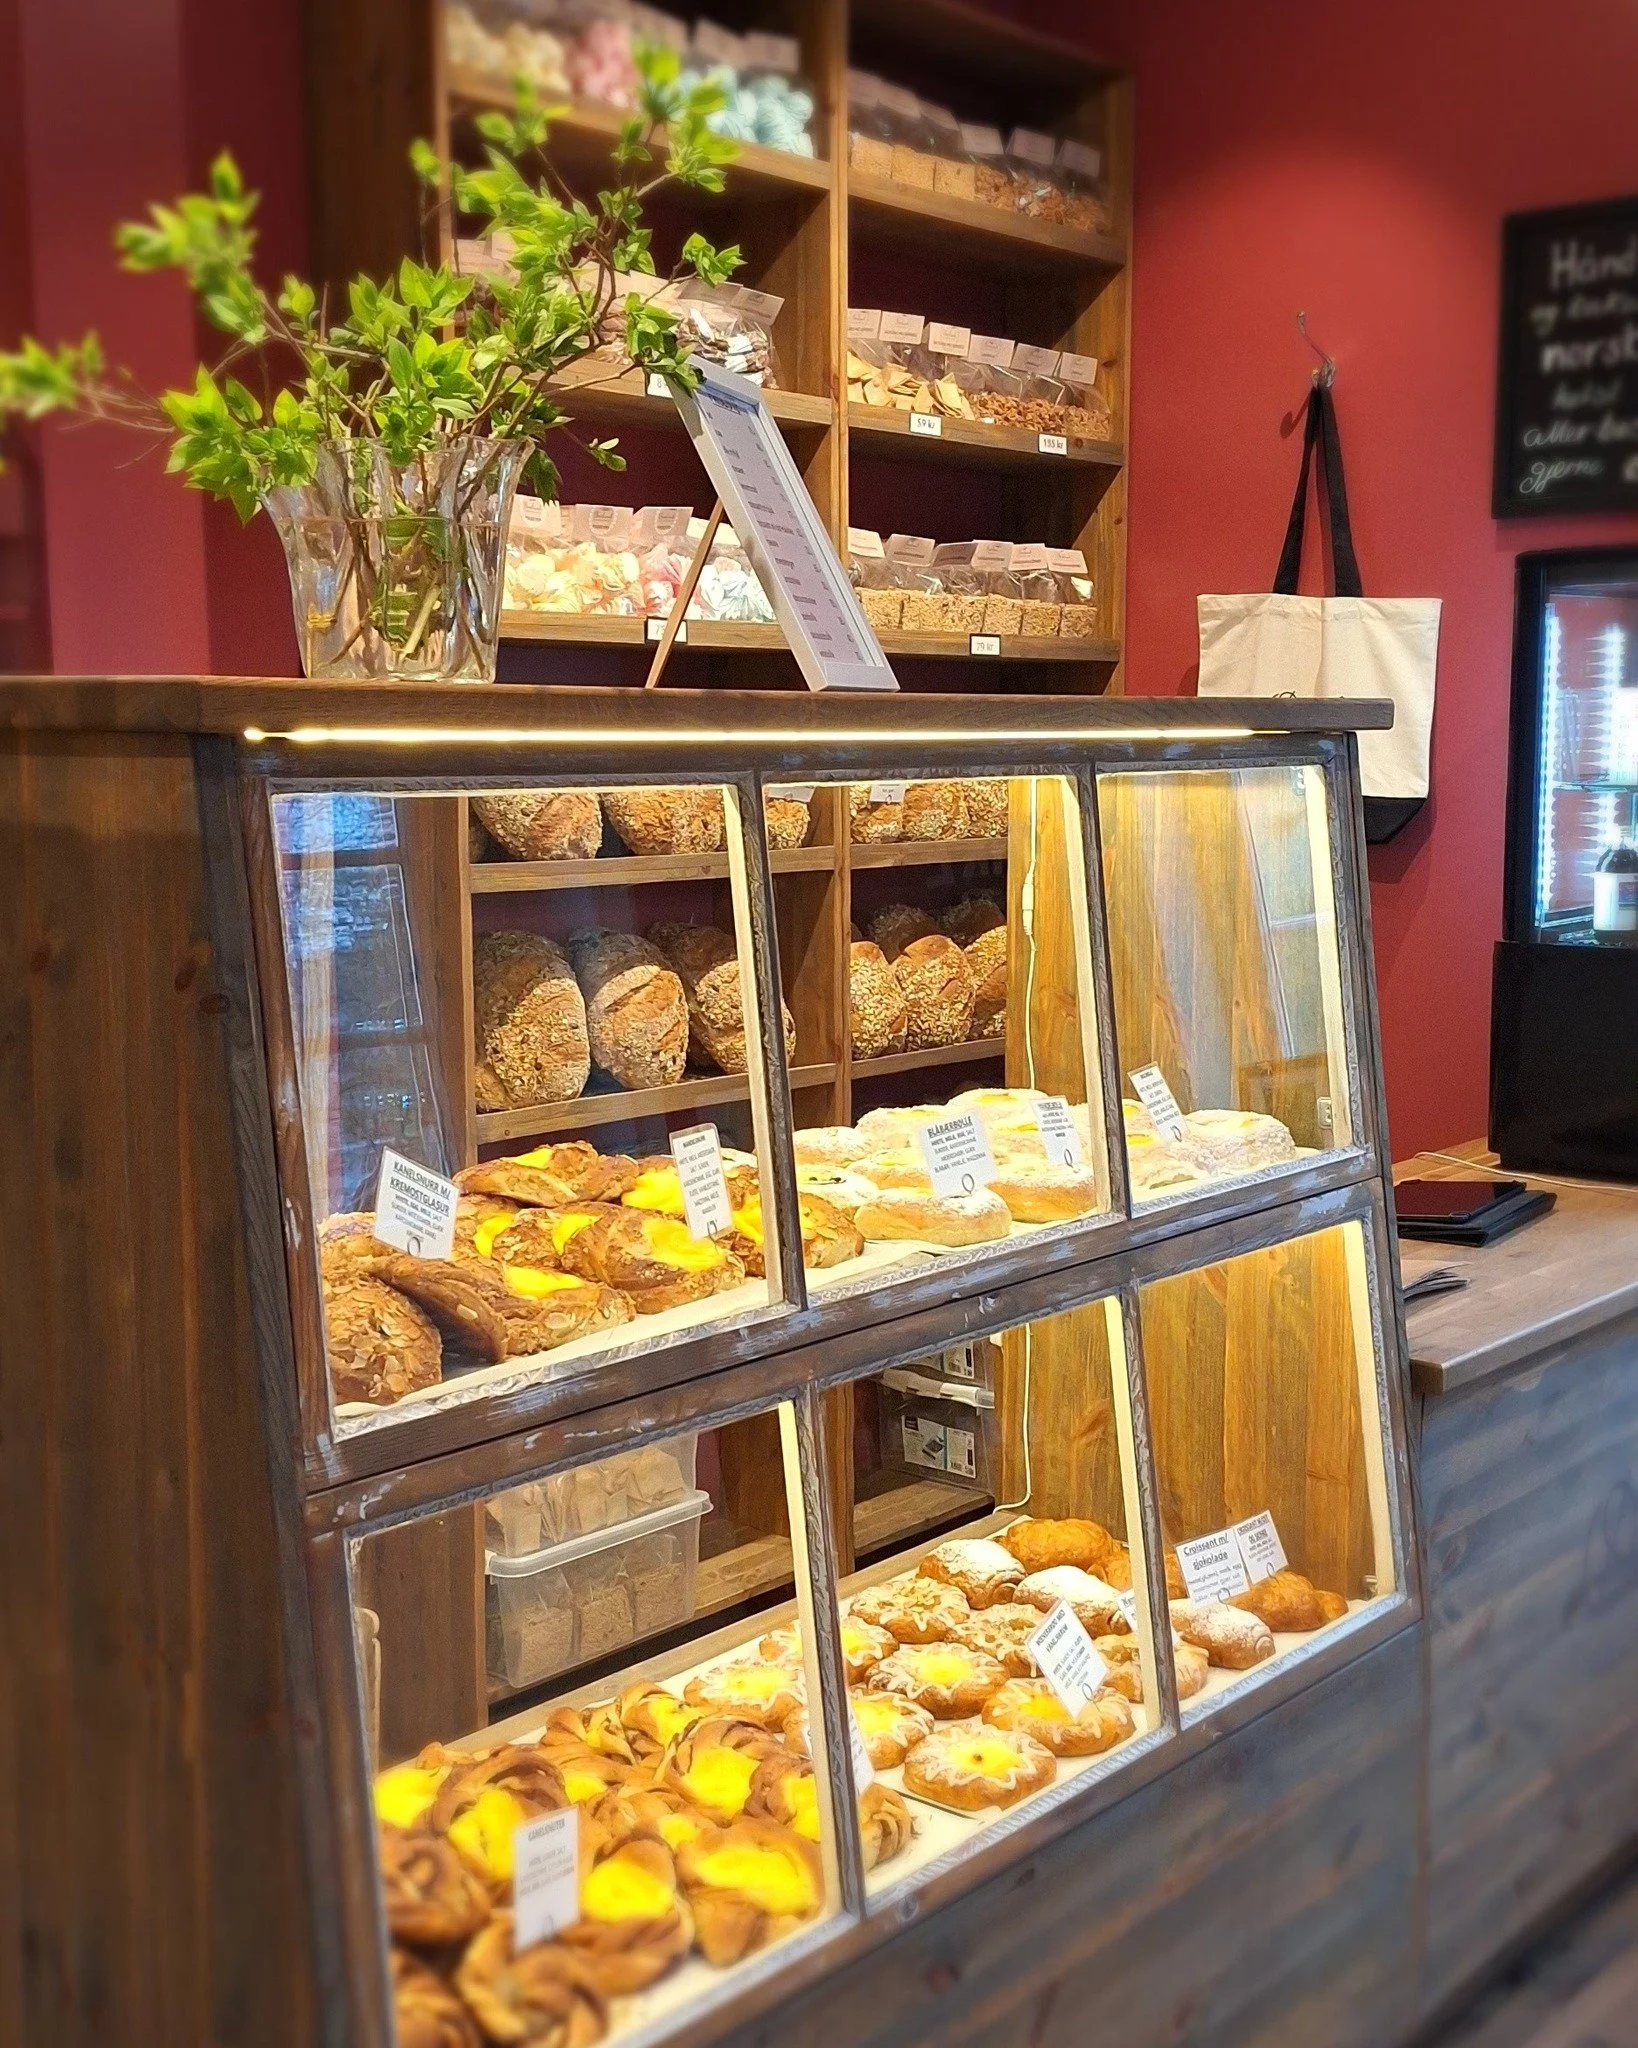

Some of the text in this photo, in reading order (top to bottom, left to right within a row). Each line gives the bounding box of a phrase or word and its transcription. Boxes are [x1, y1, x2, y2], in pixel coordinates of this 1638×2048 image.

[917, 418, 926, 428] 59
[927, 1115, 973, 1138] BLÅBÆRBOLLE
[389, 1176, 450, 1214] KREMOSTGLASUR
[1183, 1537, 1219, 1556] Croissant
[1192, 1550, 1229, 1570] sjokolade
